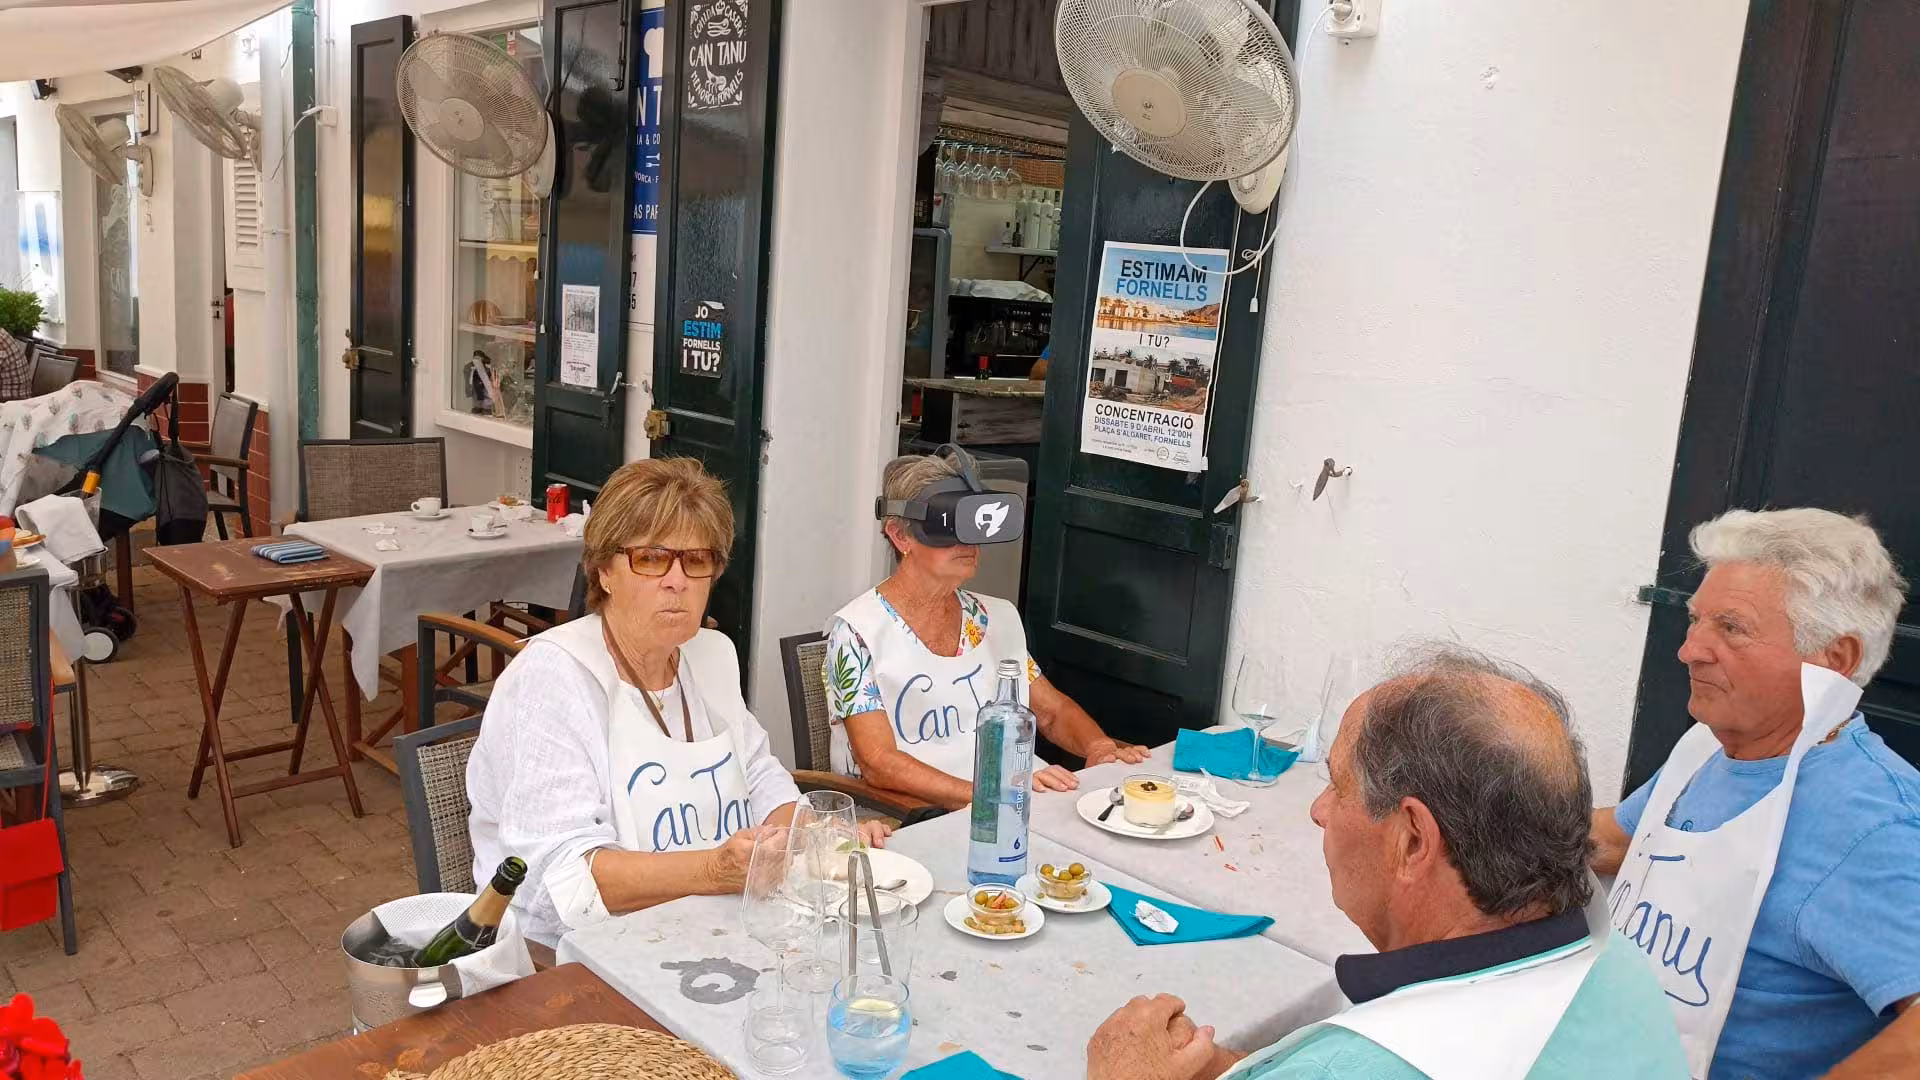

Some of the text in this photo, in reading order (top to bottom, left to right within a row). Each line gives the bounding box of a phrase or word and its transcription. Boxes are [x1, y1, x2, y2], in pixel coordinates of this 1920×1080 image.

[689, 41, 747, 67] CAN TANU
[1121, 259, 1208, 284] ESTIMAM
[1116, 278, 1208, 302] FORNELLS
[695, 305, 709, 319] JO
[683, 338, 721, 351] FORNELLS
[1148, 334, 1170, 349] TU?
[683, 349, 720, 372] I TU?
[1094, 416, 1129, 429] DISSABTE
[1095, 403, 1194, 430] CONCENTRACIÓ
[1153, 435, 1191, 449] FORNELLS
[941, 512, 947, 527] 1
[895, 673, 966, 744] Can
